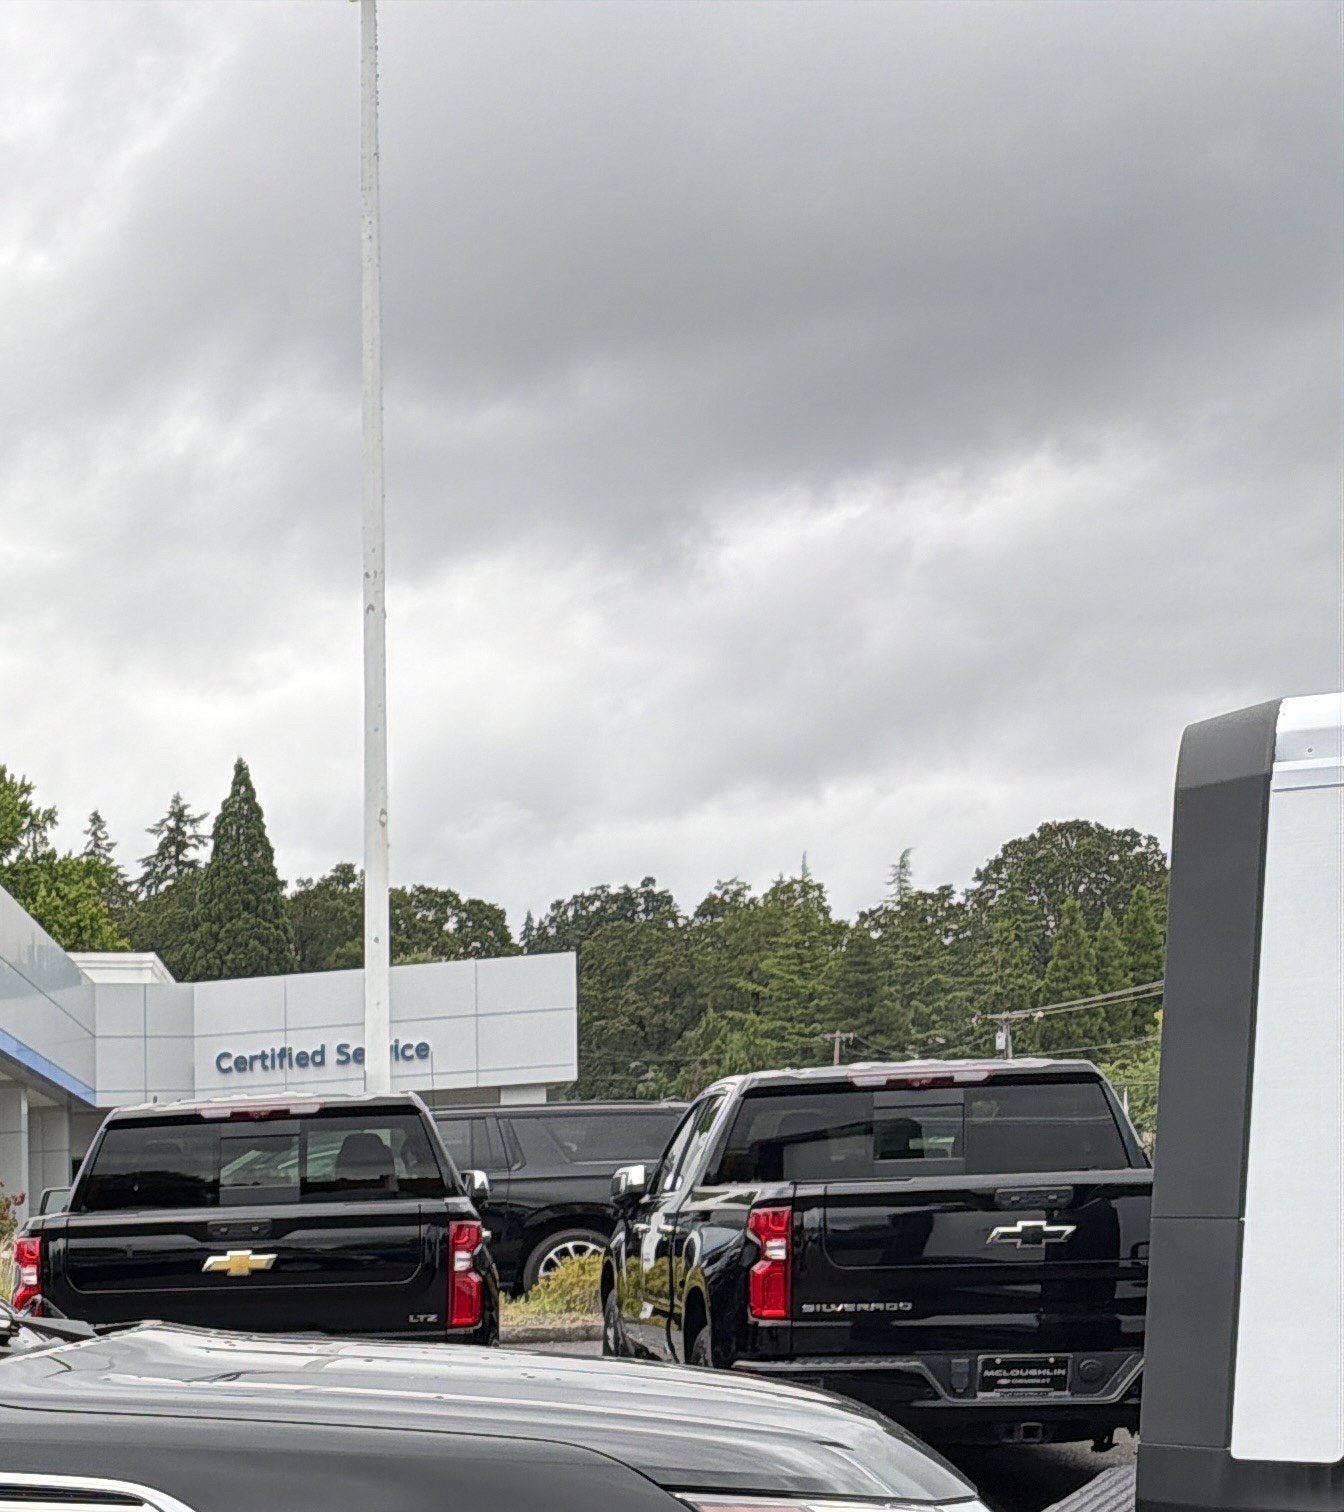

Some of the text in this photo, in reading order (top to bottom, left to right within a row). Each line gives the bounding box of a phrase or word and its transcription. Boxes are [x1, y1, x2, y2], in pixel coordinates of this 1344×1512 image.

[215, 1038, 430, 1074] Certified Seice
[802, 1302, 912, 1312] SILVERADO
[408, 1314, 439, 1323] LTZ
